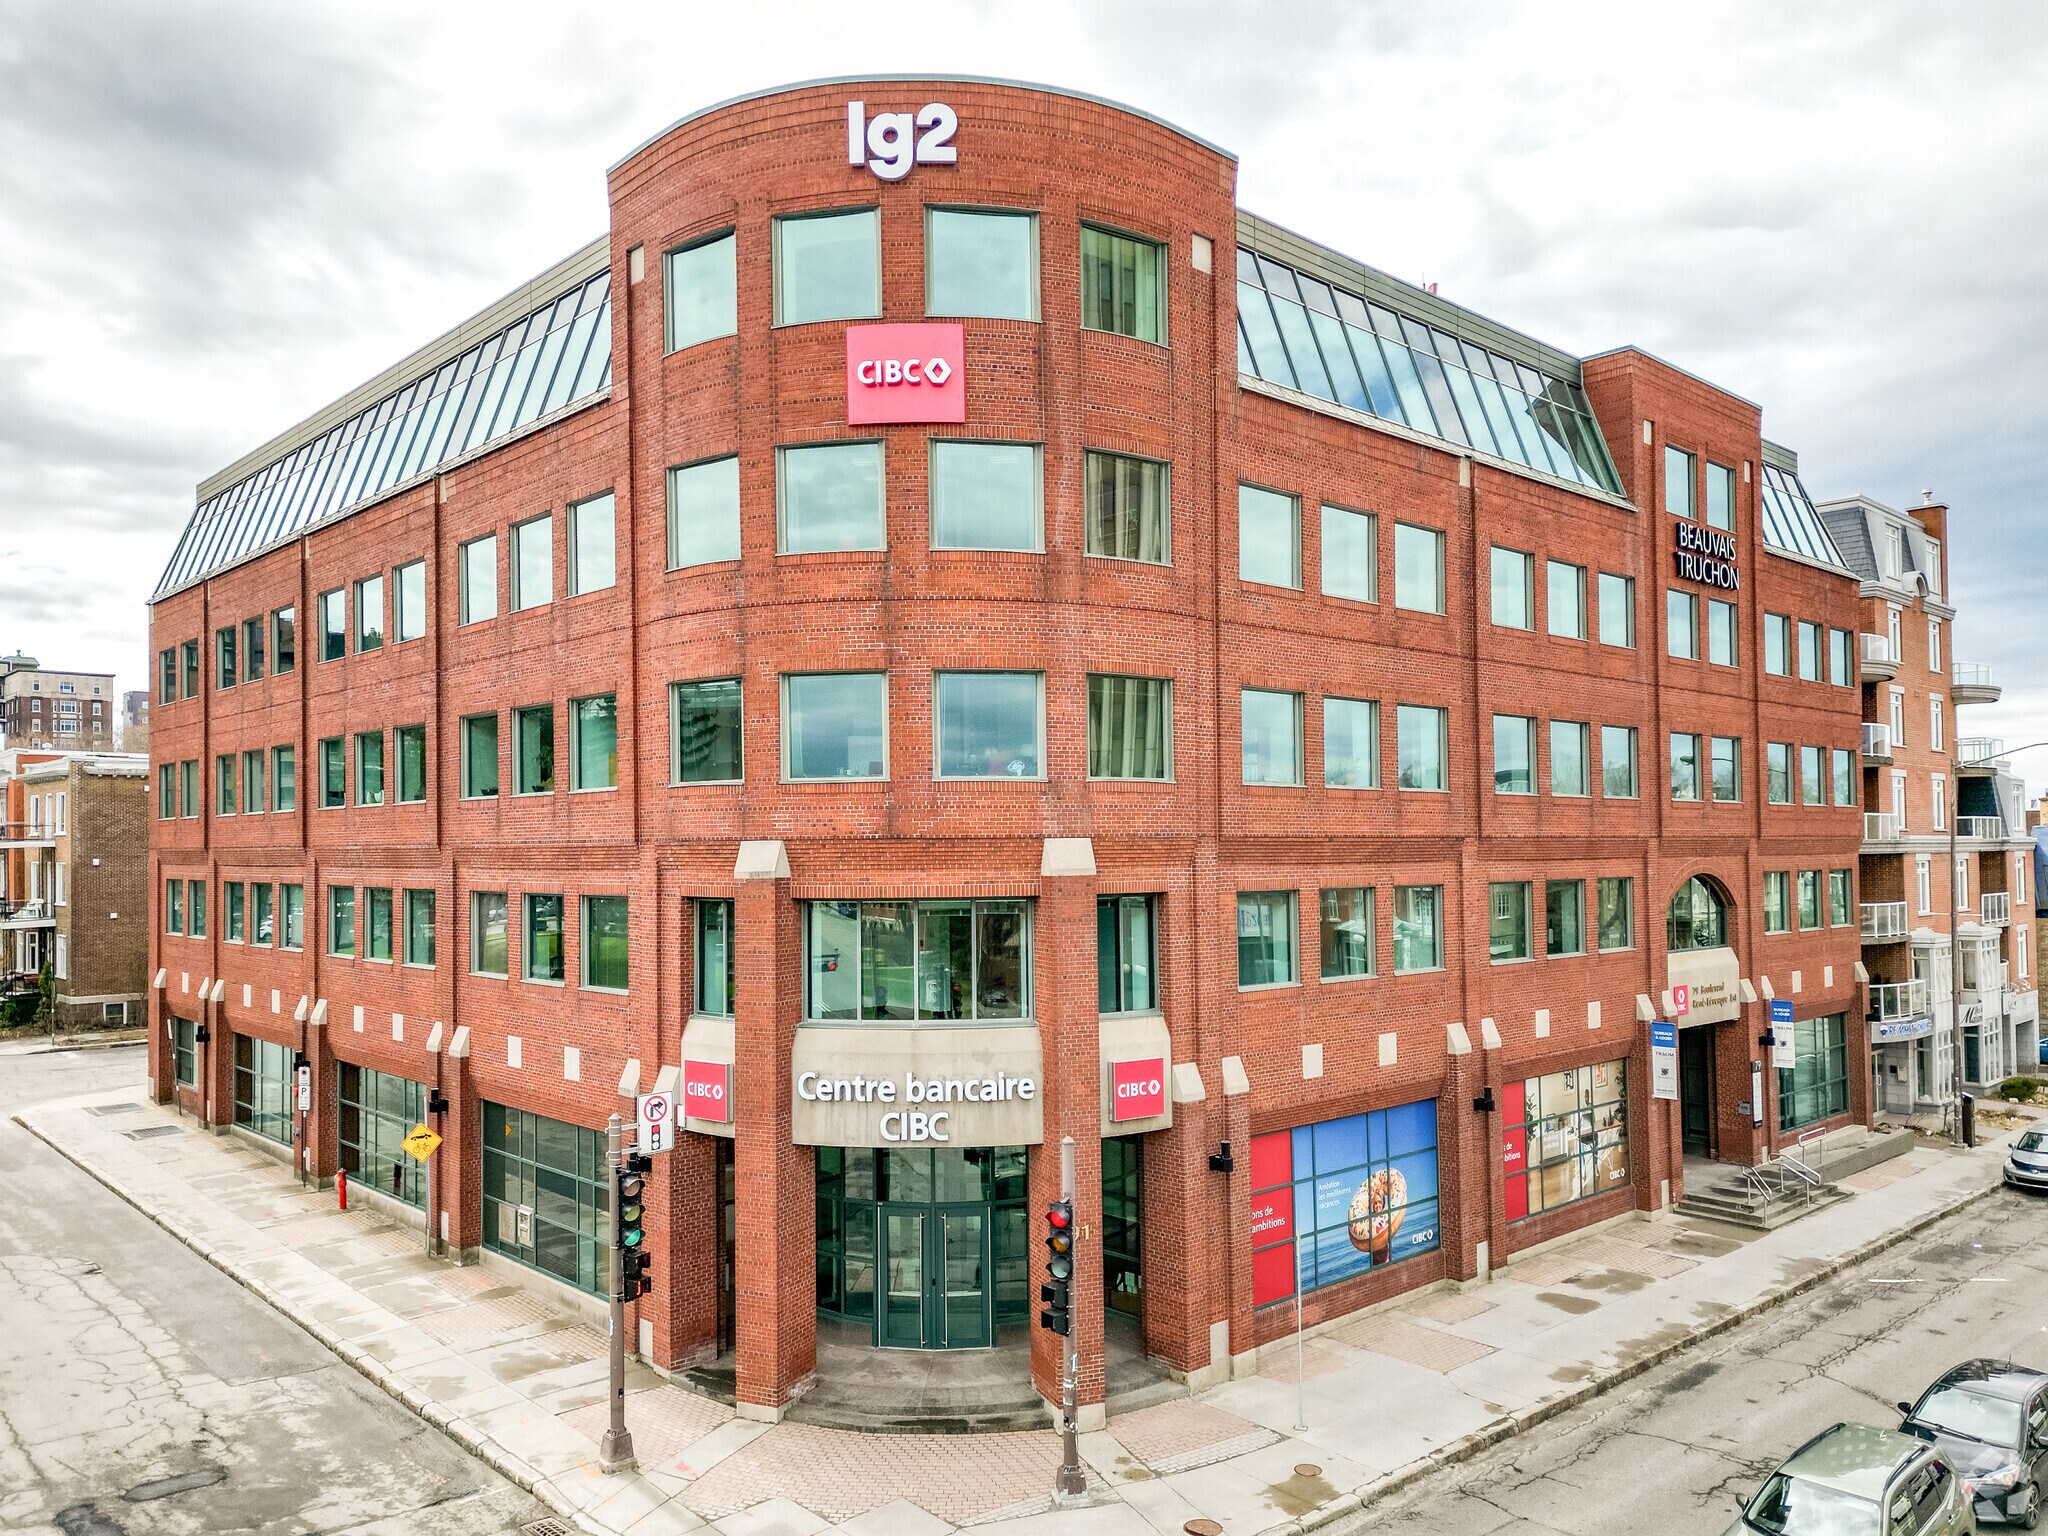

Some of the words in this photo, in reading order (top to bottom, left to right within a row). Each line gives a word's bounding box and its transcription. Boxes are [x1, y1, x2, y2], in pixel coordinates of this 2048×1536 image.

[848, 101, 958, 181] lg2
[857, 358, 921, 384] CIBC
[1678, 522, 1737, 561] BEAUVAIS
[1677, 552, 1740, 590] TRUCHON
[687, 1081, 711, 1098] CIBC
[797, 1071, 896, 1103] Centre
[906, 1071, 1036, 1103] bancaire
[1118, 1081, 1147, 1098] CIBC
[879, 1111, 949, 1142] CIBC
[1264, 1205, 1274, 1217] de
[1251, 1217, 1286, 1233] ambitions
[1412, 1230, 1428, 1245] CIBC
